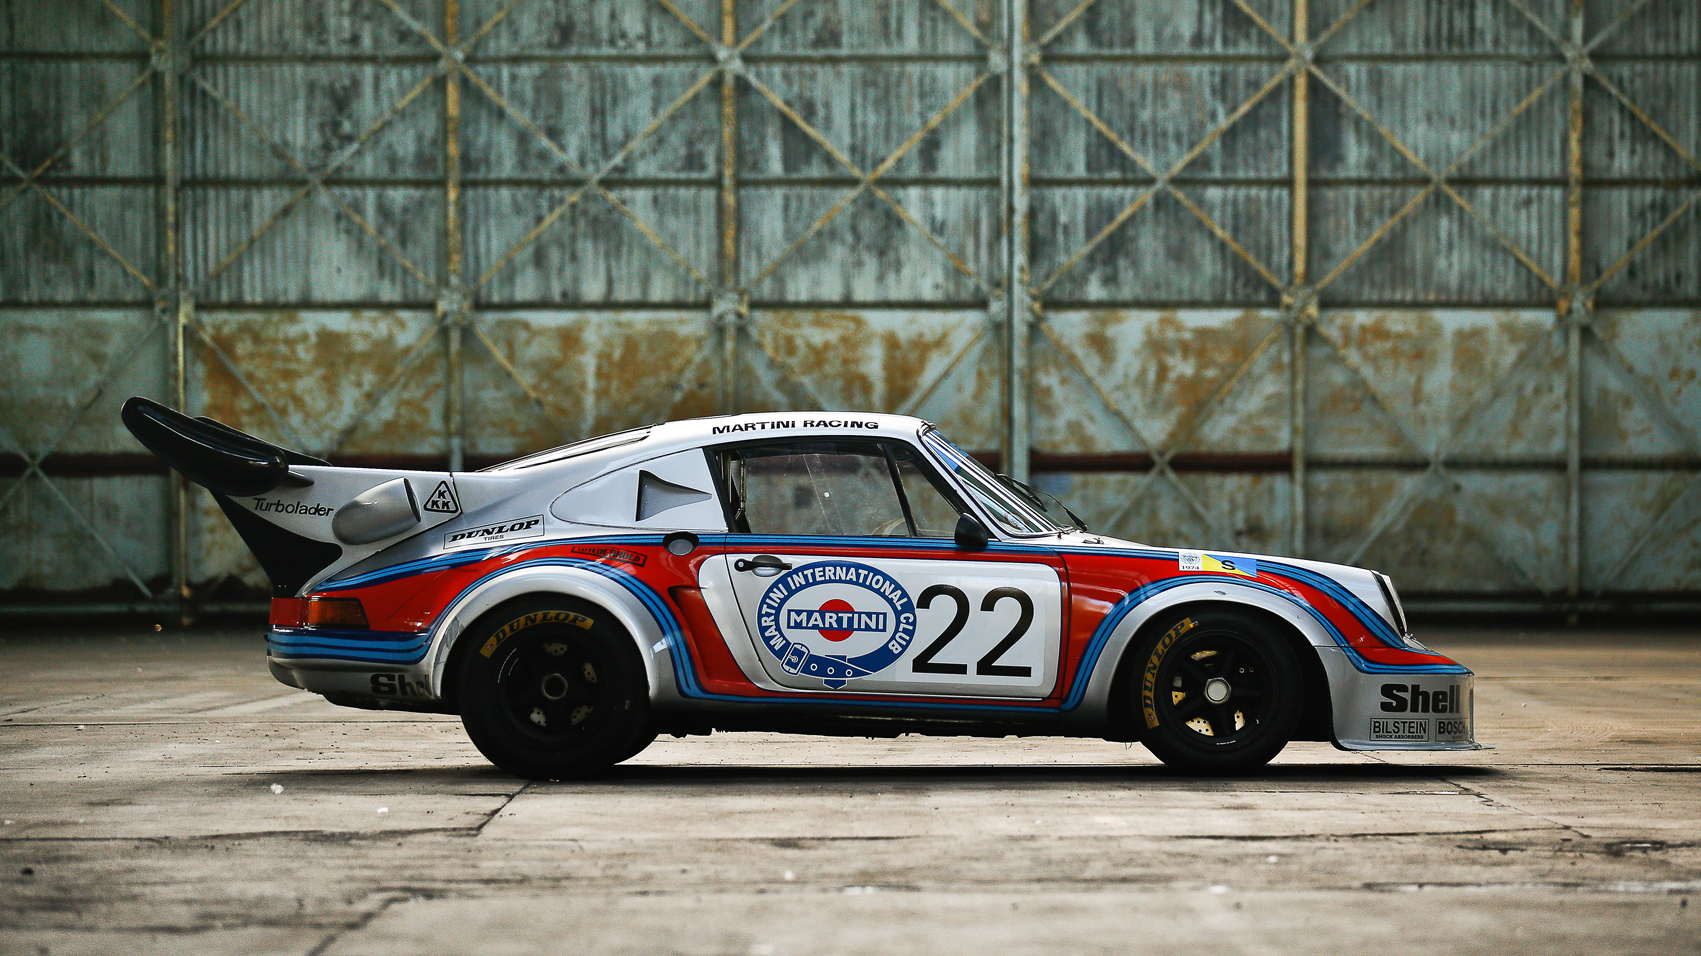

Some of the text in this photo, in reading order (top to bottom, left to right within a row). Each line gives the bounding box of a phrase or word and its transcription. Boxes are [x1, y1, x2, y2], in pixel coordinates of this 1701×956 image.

[712, 420, 879, 435] MARTINI RACING
[431, 499, 452, 510] KK
[437, 489, 448, 500] K
[253, 497, 335, 517] Turbolader
[449, 519, 540, 543] DUNLOP
[484, 534, 504, 542] TIRES
[1221, 559, 1236, 571] S
[761, 565, 914, 655] MARTINI INTERNATIONAL CLUB
[789, 610, 885, 630] MARTINI
[494, 610, 588, 646] DUNLOP
[911, 584, 1035, 678] 22
[1143, 620, 1186, 712] DUNLOP
[1380, 683, 1460, 713] Shell
[1373, 720, 1427, 734] BILSTEIN
